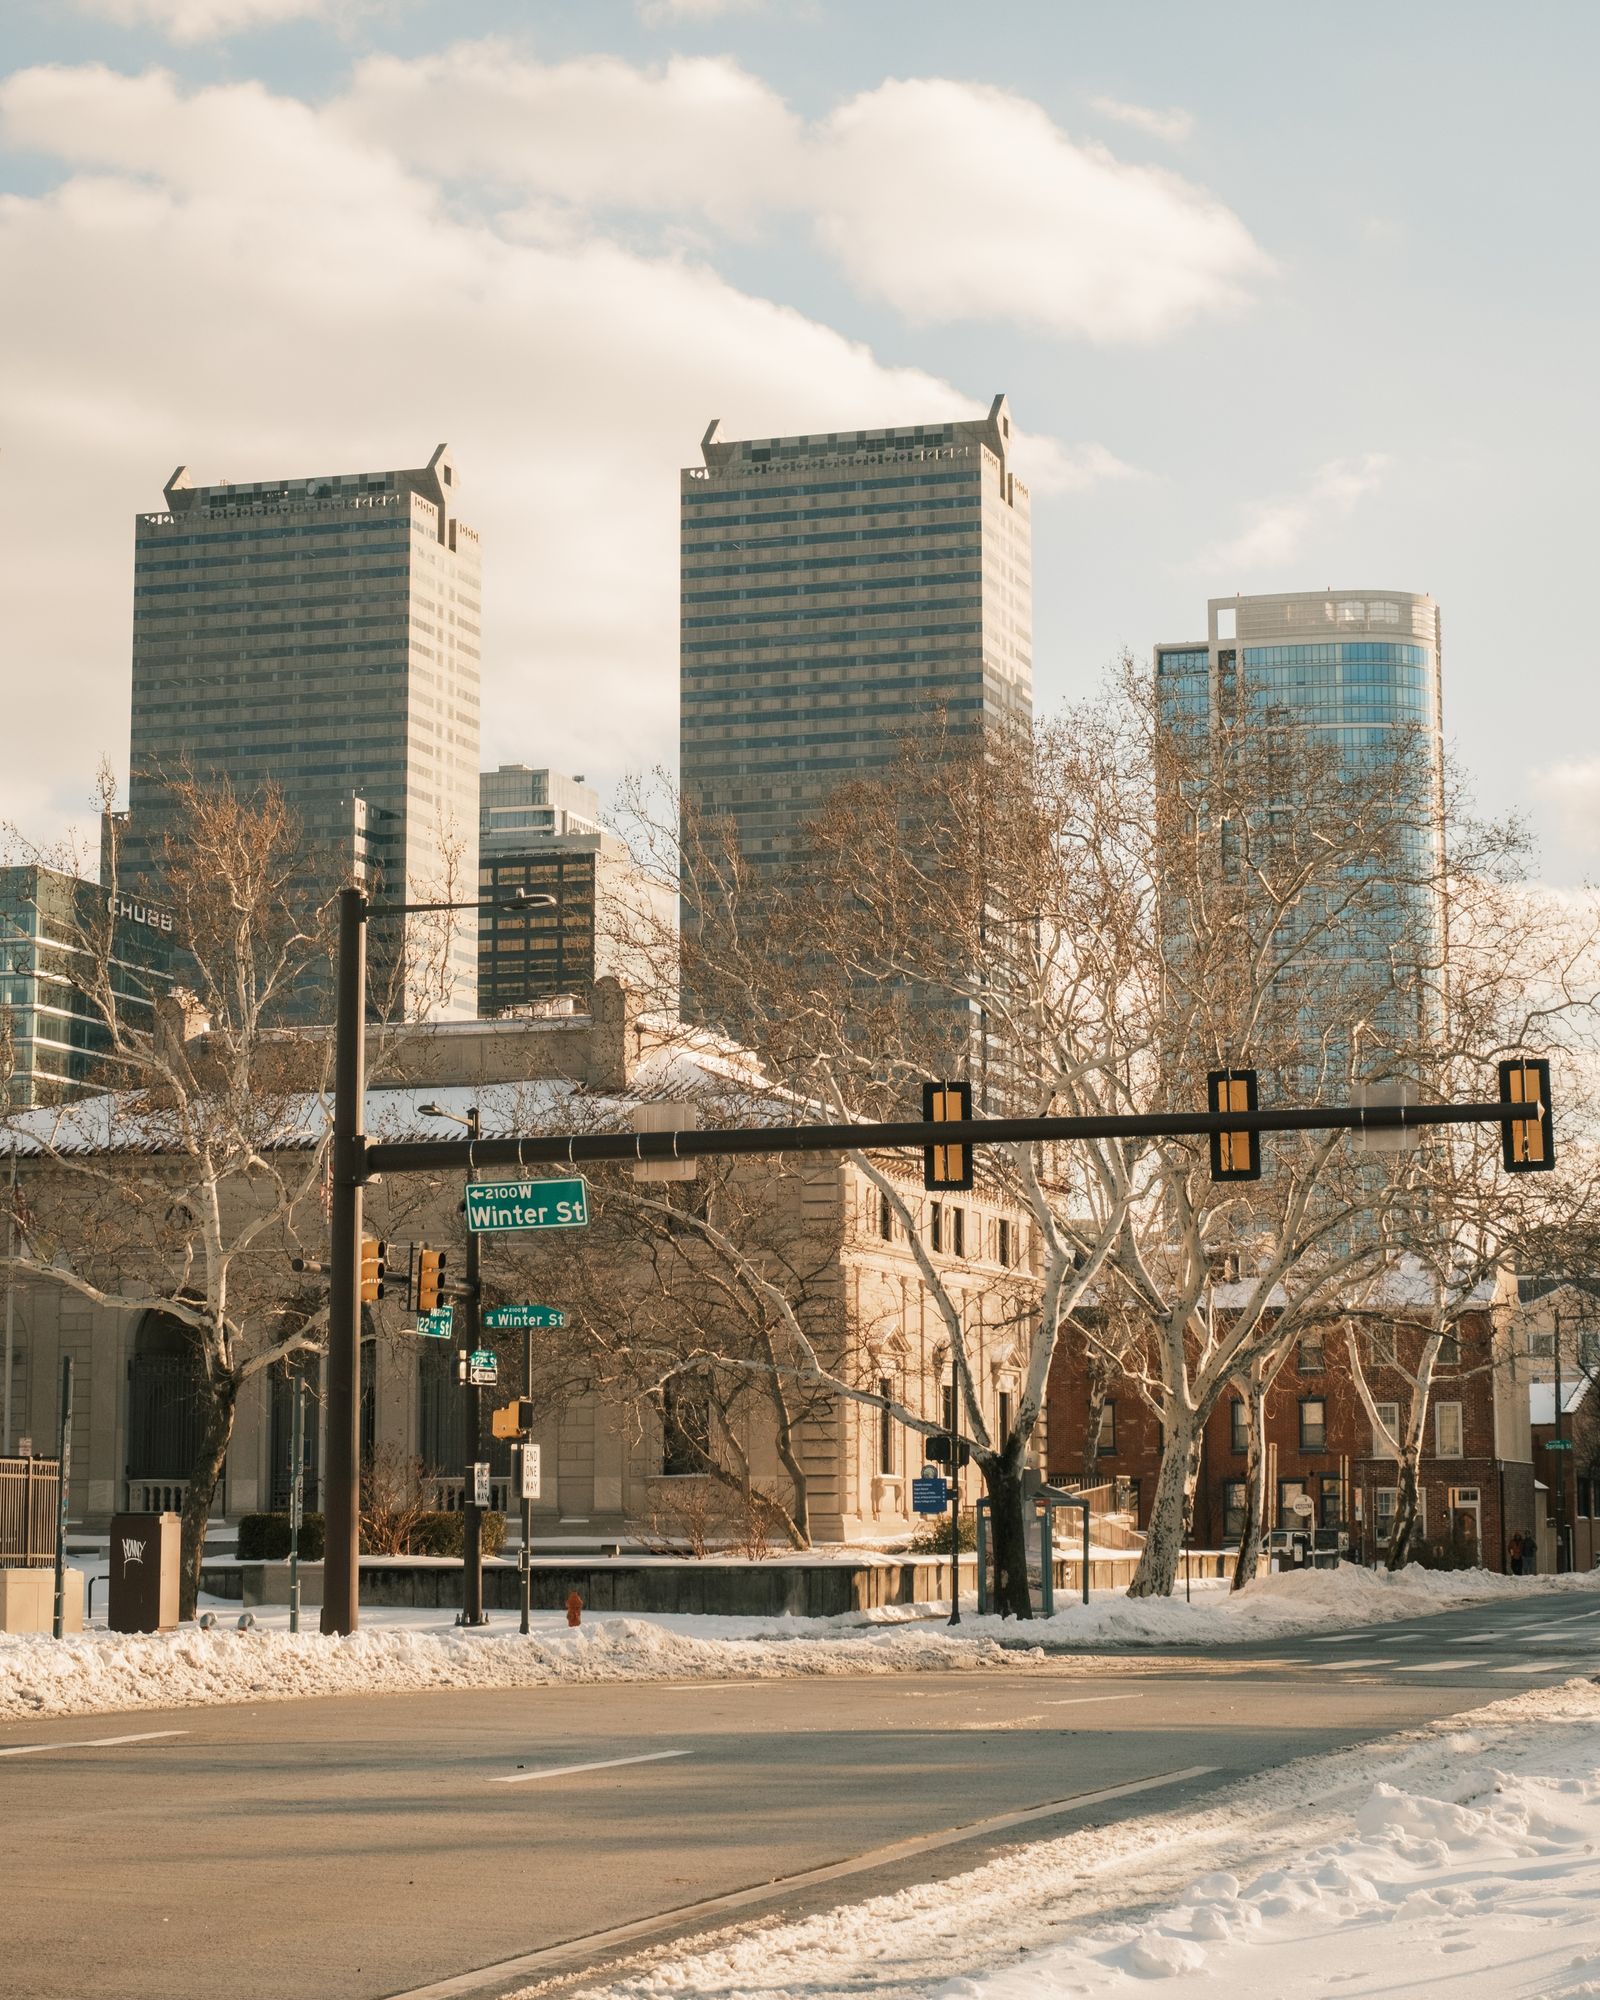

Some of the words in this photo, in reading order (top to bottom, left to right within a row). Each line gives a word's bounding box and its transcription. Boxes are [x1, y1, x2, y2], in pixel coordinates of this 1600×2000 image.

[471, 1205, 548, 1227] Winter
[556, 1201, 584, 1222] St
[498, 1314, 543, 1326] Winter
[549, 1314, 564, 1326] St
[419, 1317, 437, 1333] 22nd
[439, 1320, 449, 1335] St
[526, 1451, 538, 1462] END
[477, 1468, 488, 1478] END
[526, 1465, 538, 1476] ONE
[477, 1480, 488, 1490] ONE
[526, 1481, 538, 1492] WAY
[477, 1492, 488, 1501] WAY
